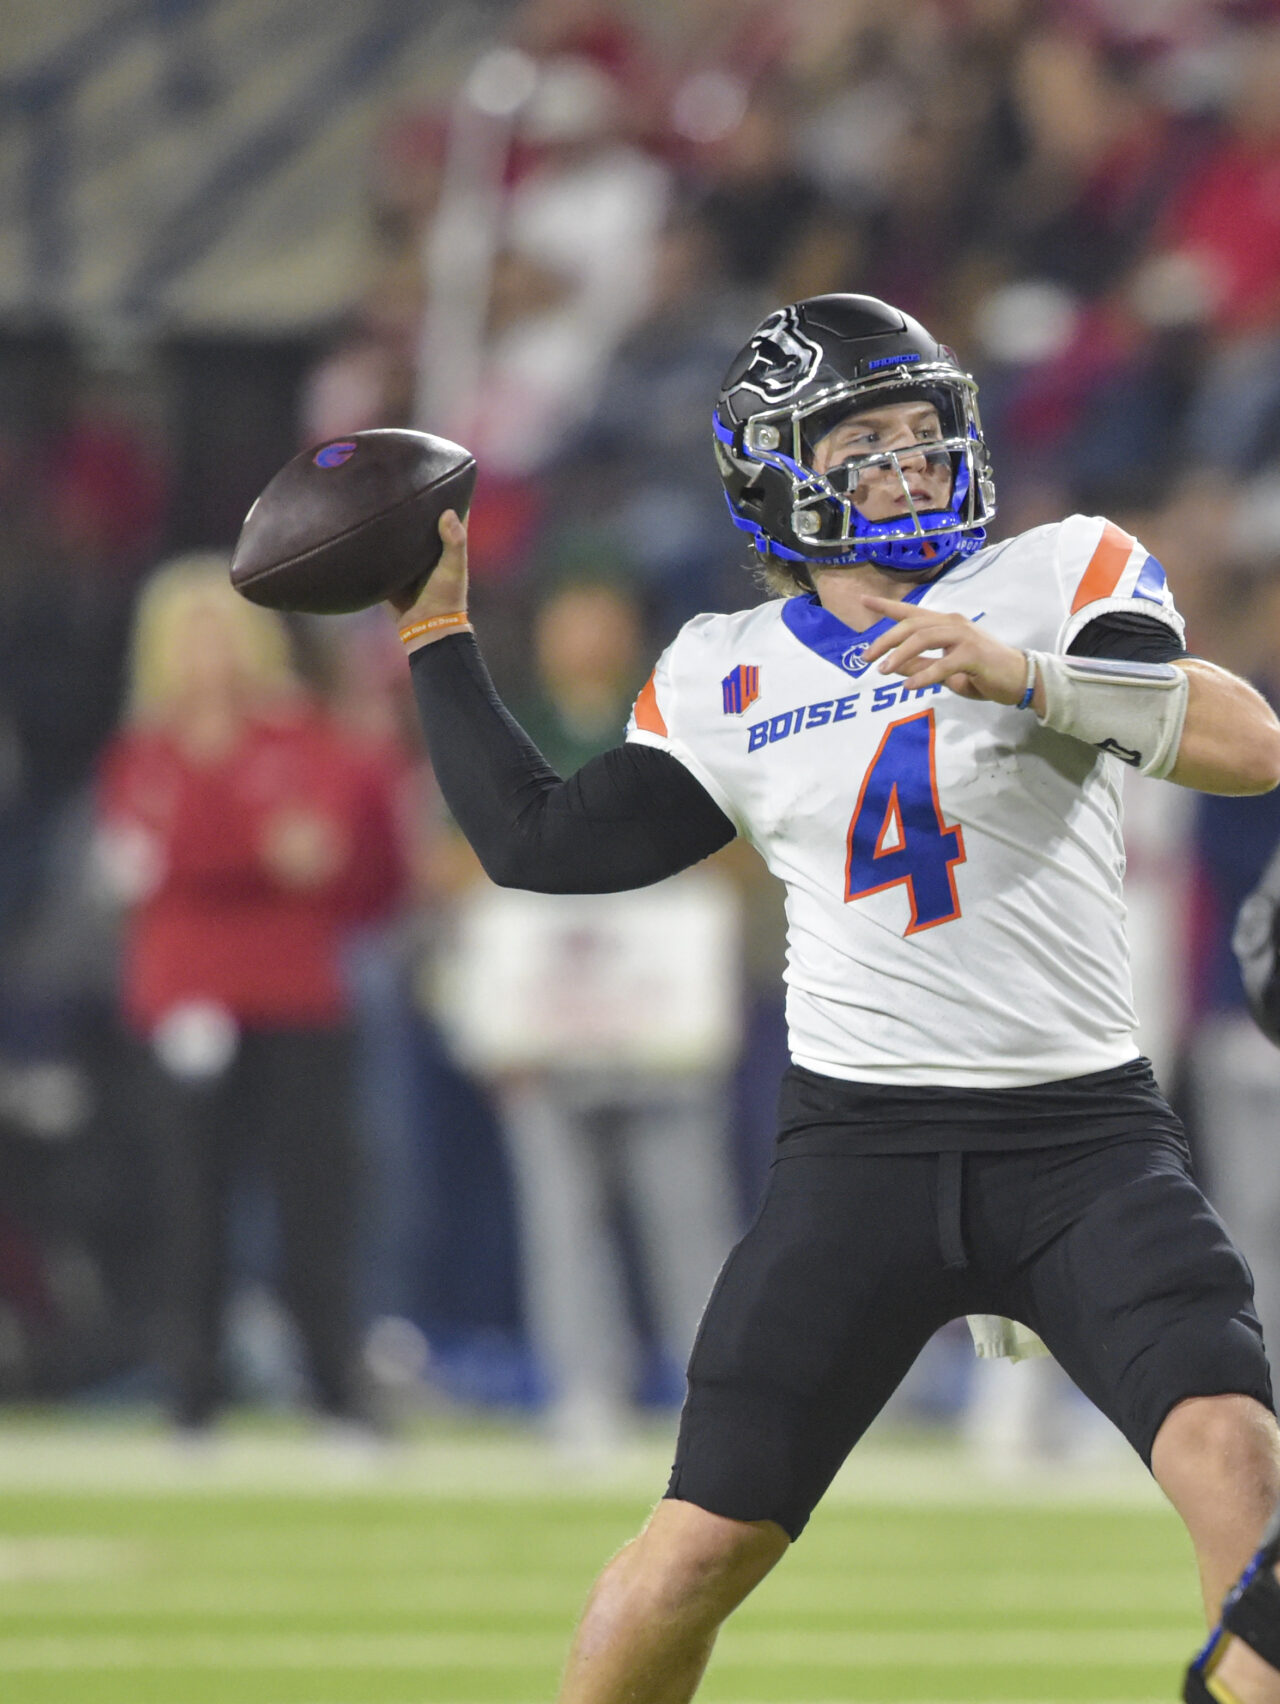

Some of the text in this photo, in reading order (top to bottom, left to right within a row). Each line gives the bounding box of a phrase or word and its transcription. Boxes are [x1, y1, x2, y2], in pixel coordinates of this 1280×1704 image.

[747, 680, 943, 754] BOISE STA
[844, 708, 967, 937] 4
